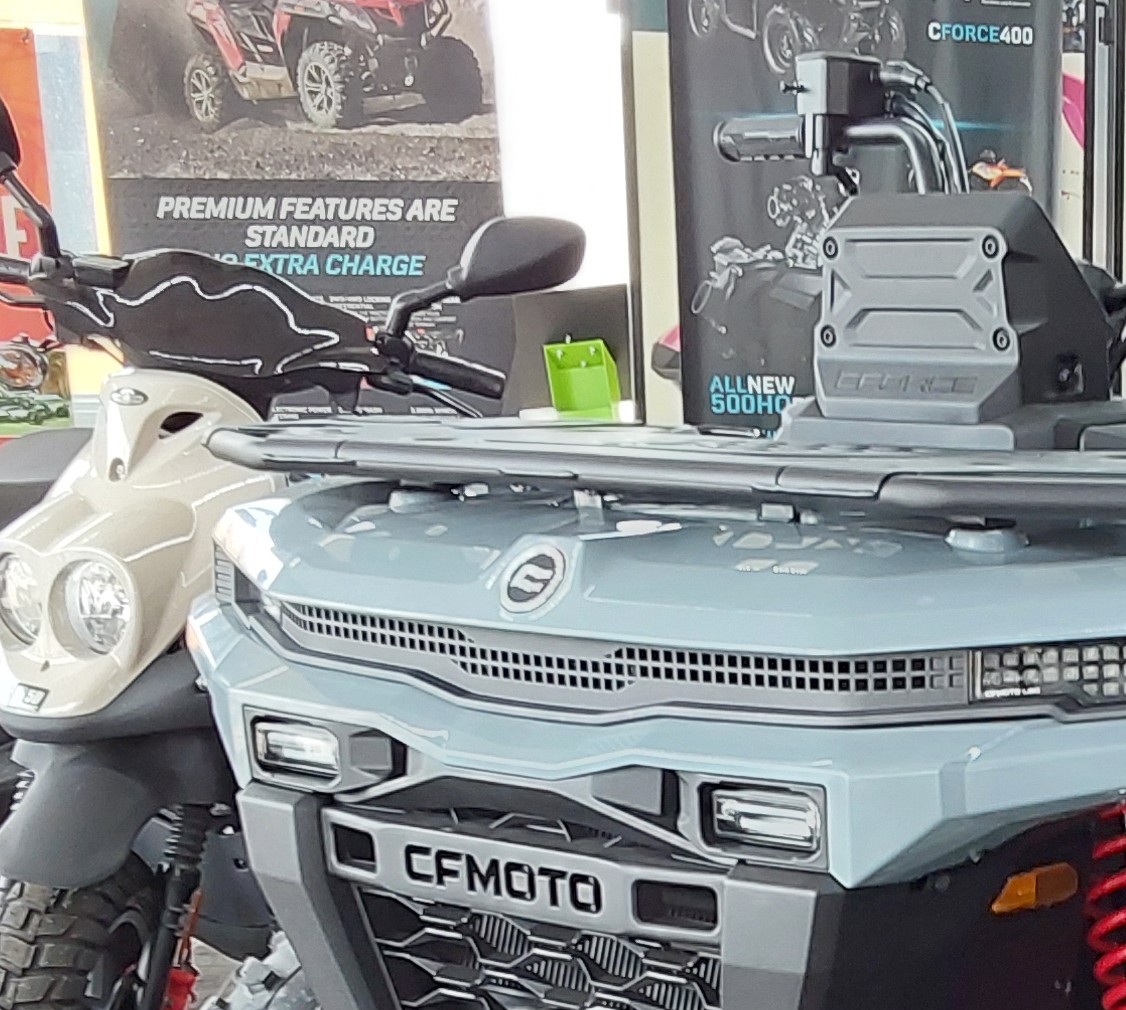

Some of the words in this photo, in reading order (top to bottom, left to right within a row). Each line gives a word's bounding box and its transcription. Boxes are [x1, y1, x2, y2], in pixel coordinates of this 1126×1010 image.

[928, 21, 1034, 45] CFORCE400
[156, 196, 275, 220] PREMIUM
[279, 196, 404, 221] FEATURES
[406, 197, 458, 221] ARE
[245, 225, 376, 248] STANDARD
[244, 253, 321, 276] EXTRA
[325, 253, 427, 276] CHARGE
[404, 844, 603, 914] CFMOTO
